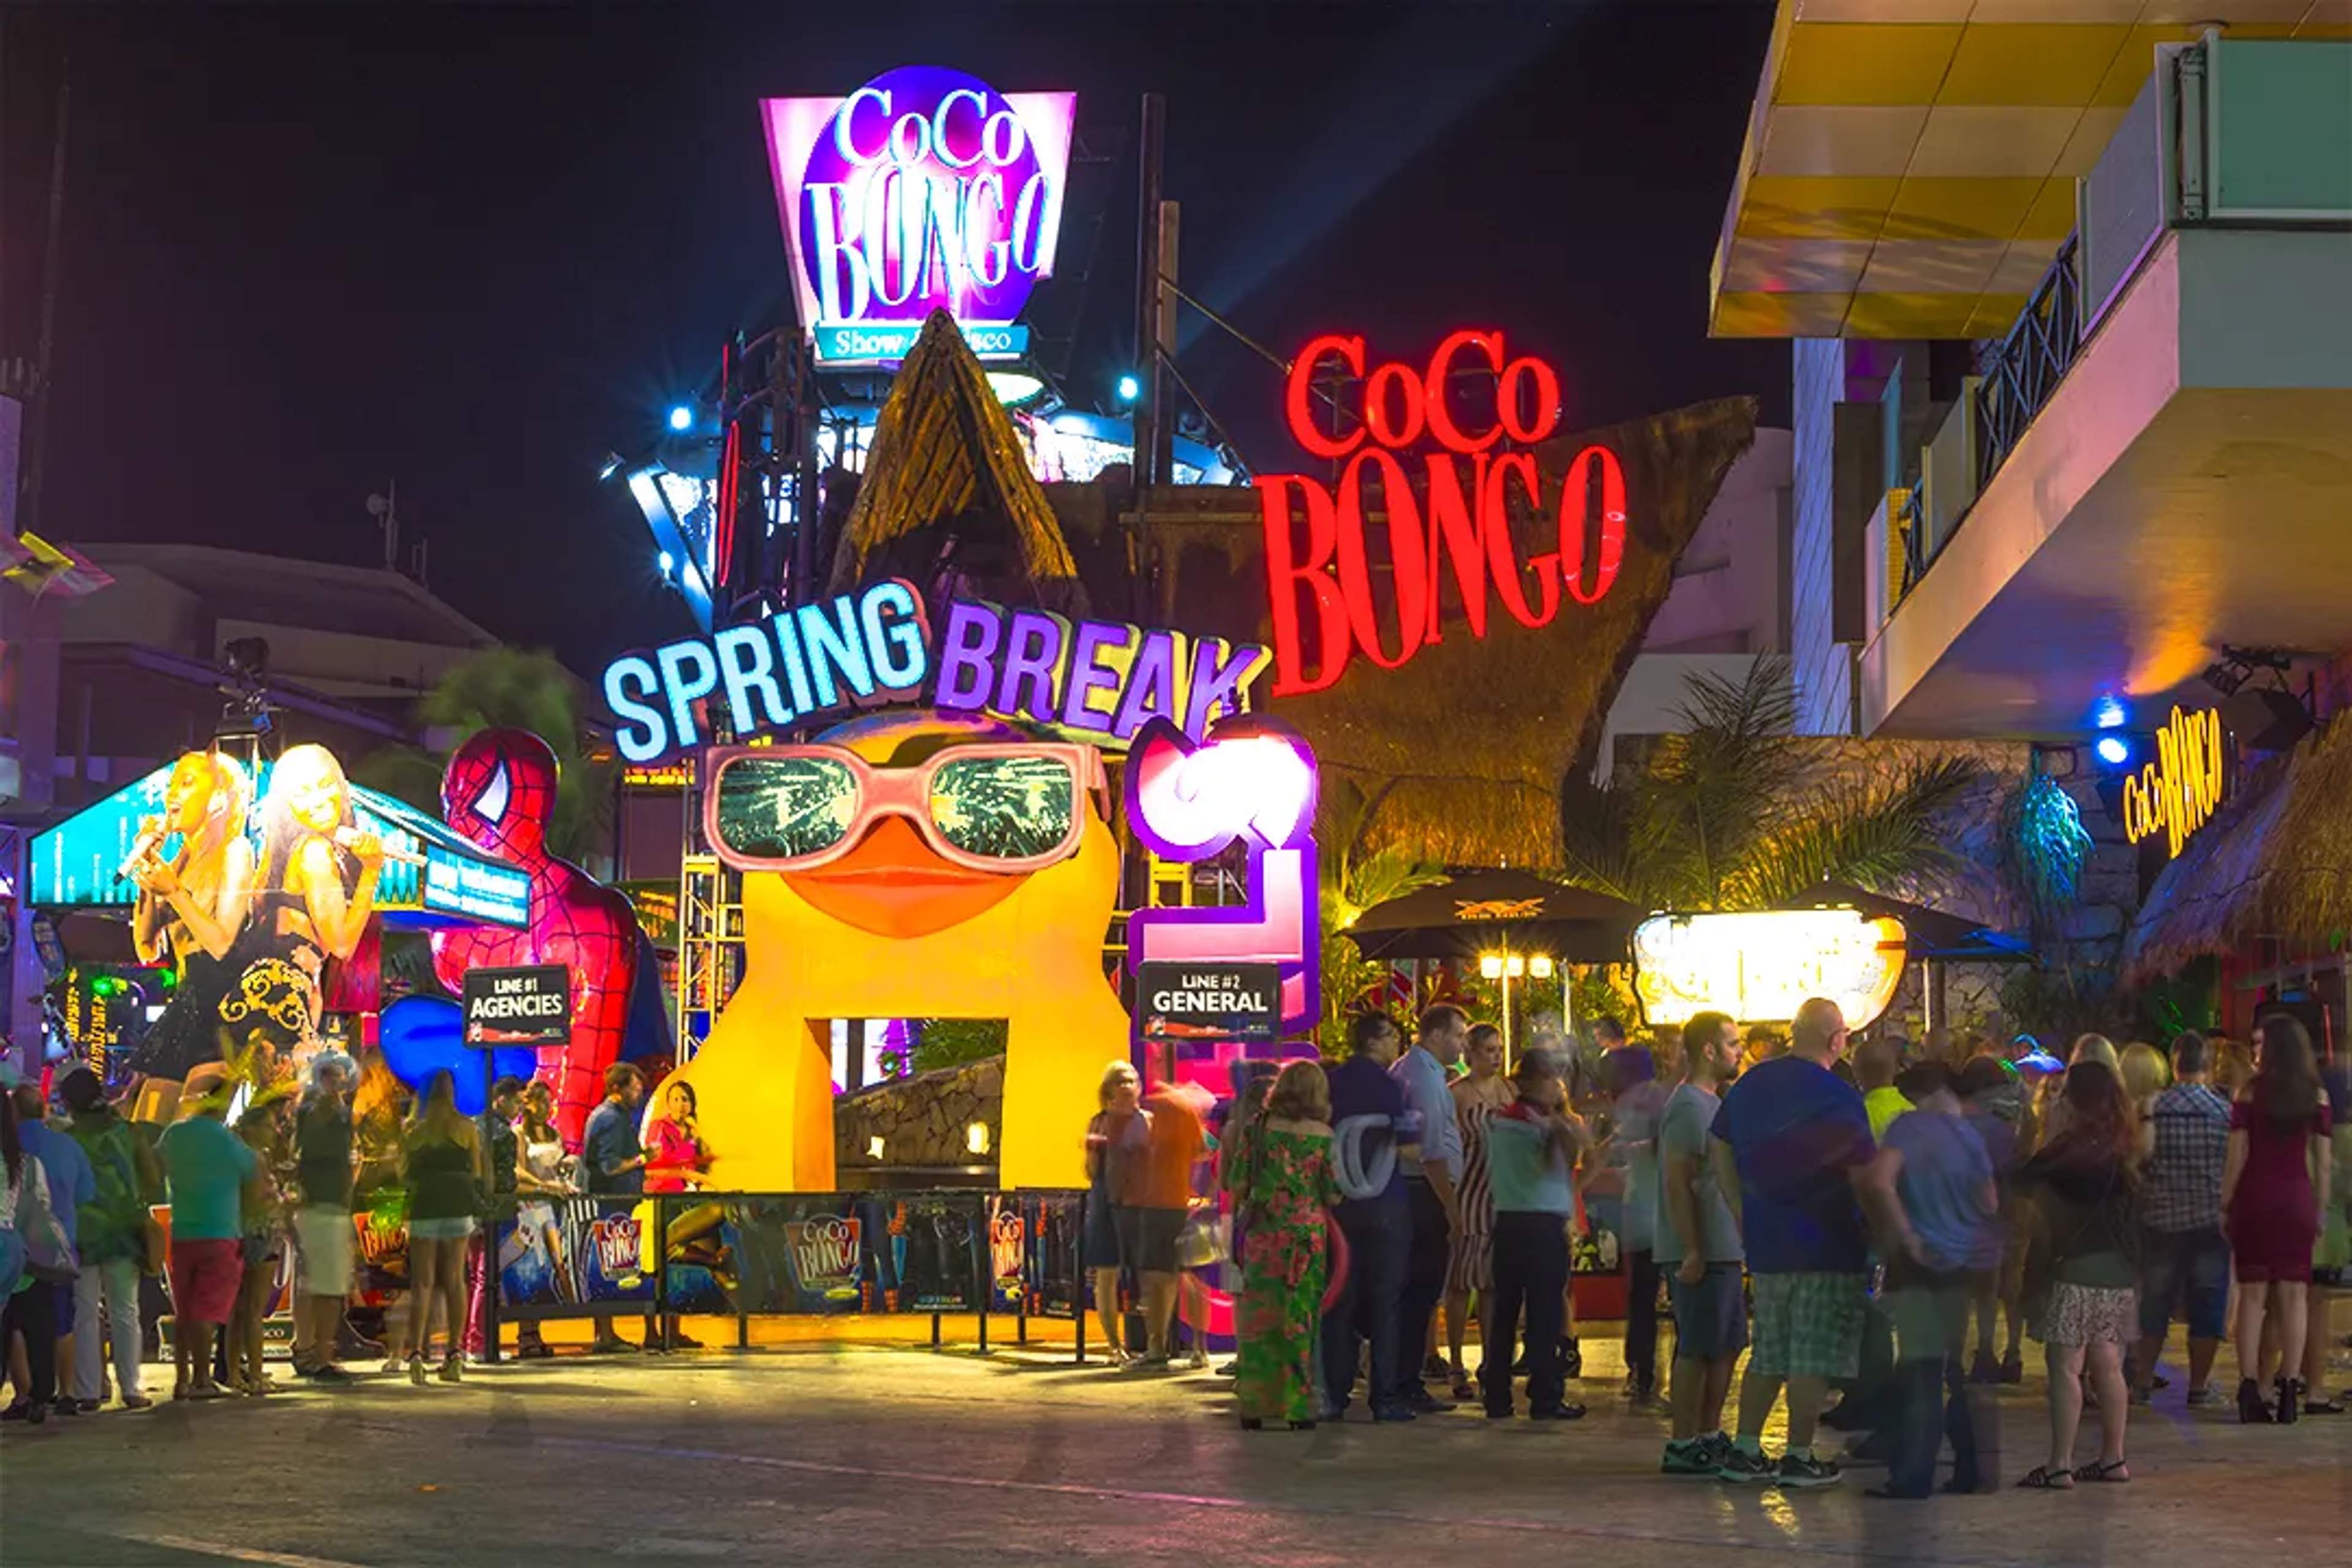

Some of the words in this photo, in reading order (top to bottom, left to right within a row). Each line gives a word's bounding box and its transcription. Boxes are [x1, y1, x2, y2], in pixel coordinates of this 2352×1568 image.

[835, 87, 1025, 168] CoCo
[804, 163, 1051, 325] BONGO
[835, 330, 904, 354] Show
[1287, 331, 1560, 458] CoCo
[1252, 446, 1627, 698] BONGO
[603, 582, 926, 762] SPRING
[935, 600, 1263, 745] BREAK
[2156, 704, 2222, 859] BONGO
[470, 993, 563, 1019] AGENCIES
[494, 978, 522, 993] LINE
[524, 978, 538, 992] #1
[1153, 990, 1268, 1012] GENERAL
[1182, 975, 1218, 989] LINE
[1222, 974, 1240, 989] #2
